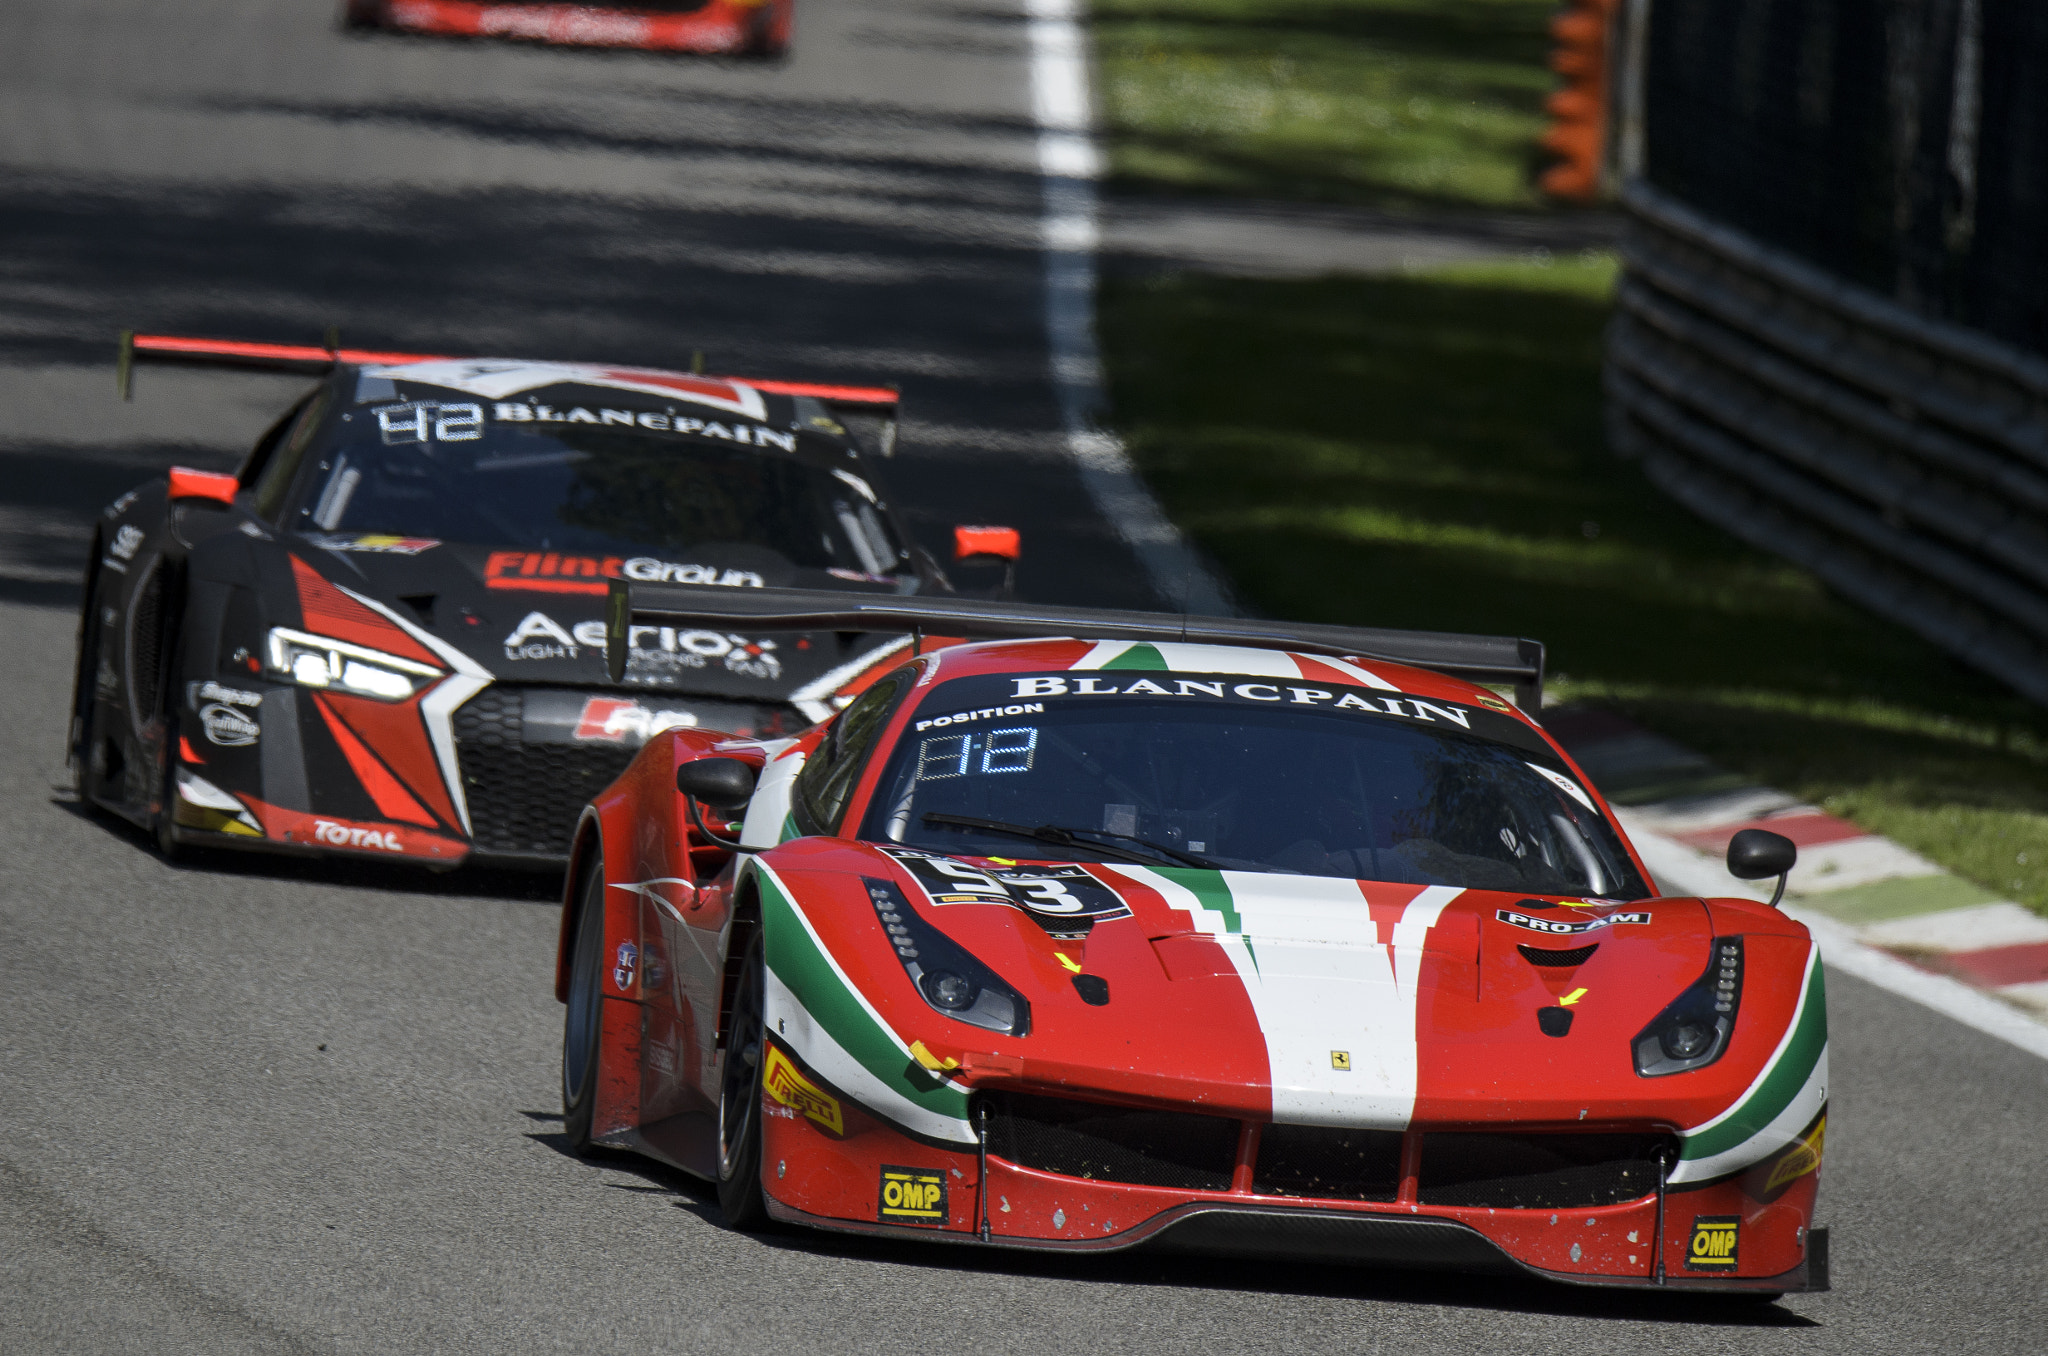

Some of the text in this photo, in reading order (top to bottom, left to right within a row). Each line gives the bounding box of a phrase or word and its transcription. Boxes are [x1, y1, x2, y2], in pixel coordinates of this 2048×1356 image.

[379, 402, 483, 443] 42
[493, 402, 797, 453] BLANCPAIN
[505, 645, 578, 660] LIGHT
[916, 703, 1044, 732] POSITION
[1010, 676, 1471, 730] BLANCPAIN
[314, 819, 404, 852] TOTAL
[925, 857, 1084, 913] 53
[1508, 912, 1641, 933] PRO-AM
[769, 1060, 836, 1124] PIRELLI
[884, 1180, 941, 1211] OMP
[1692, 1230, 1737, 1257] OMP
